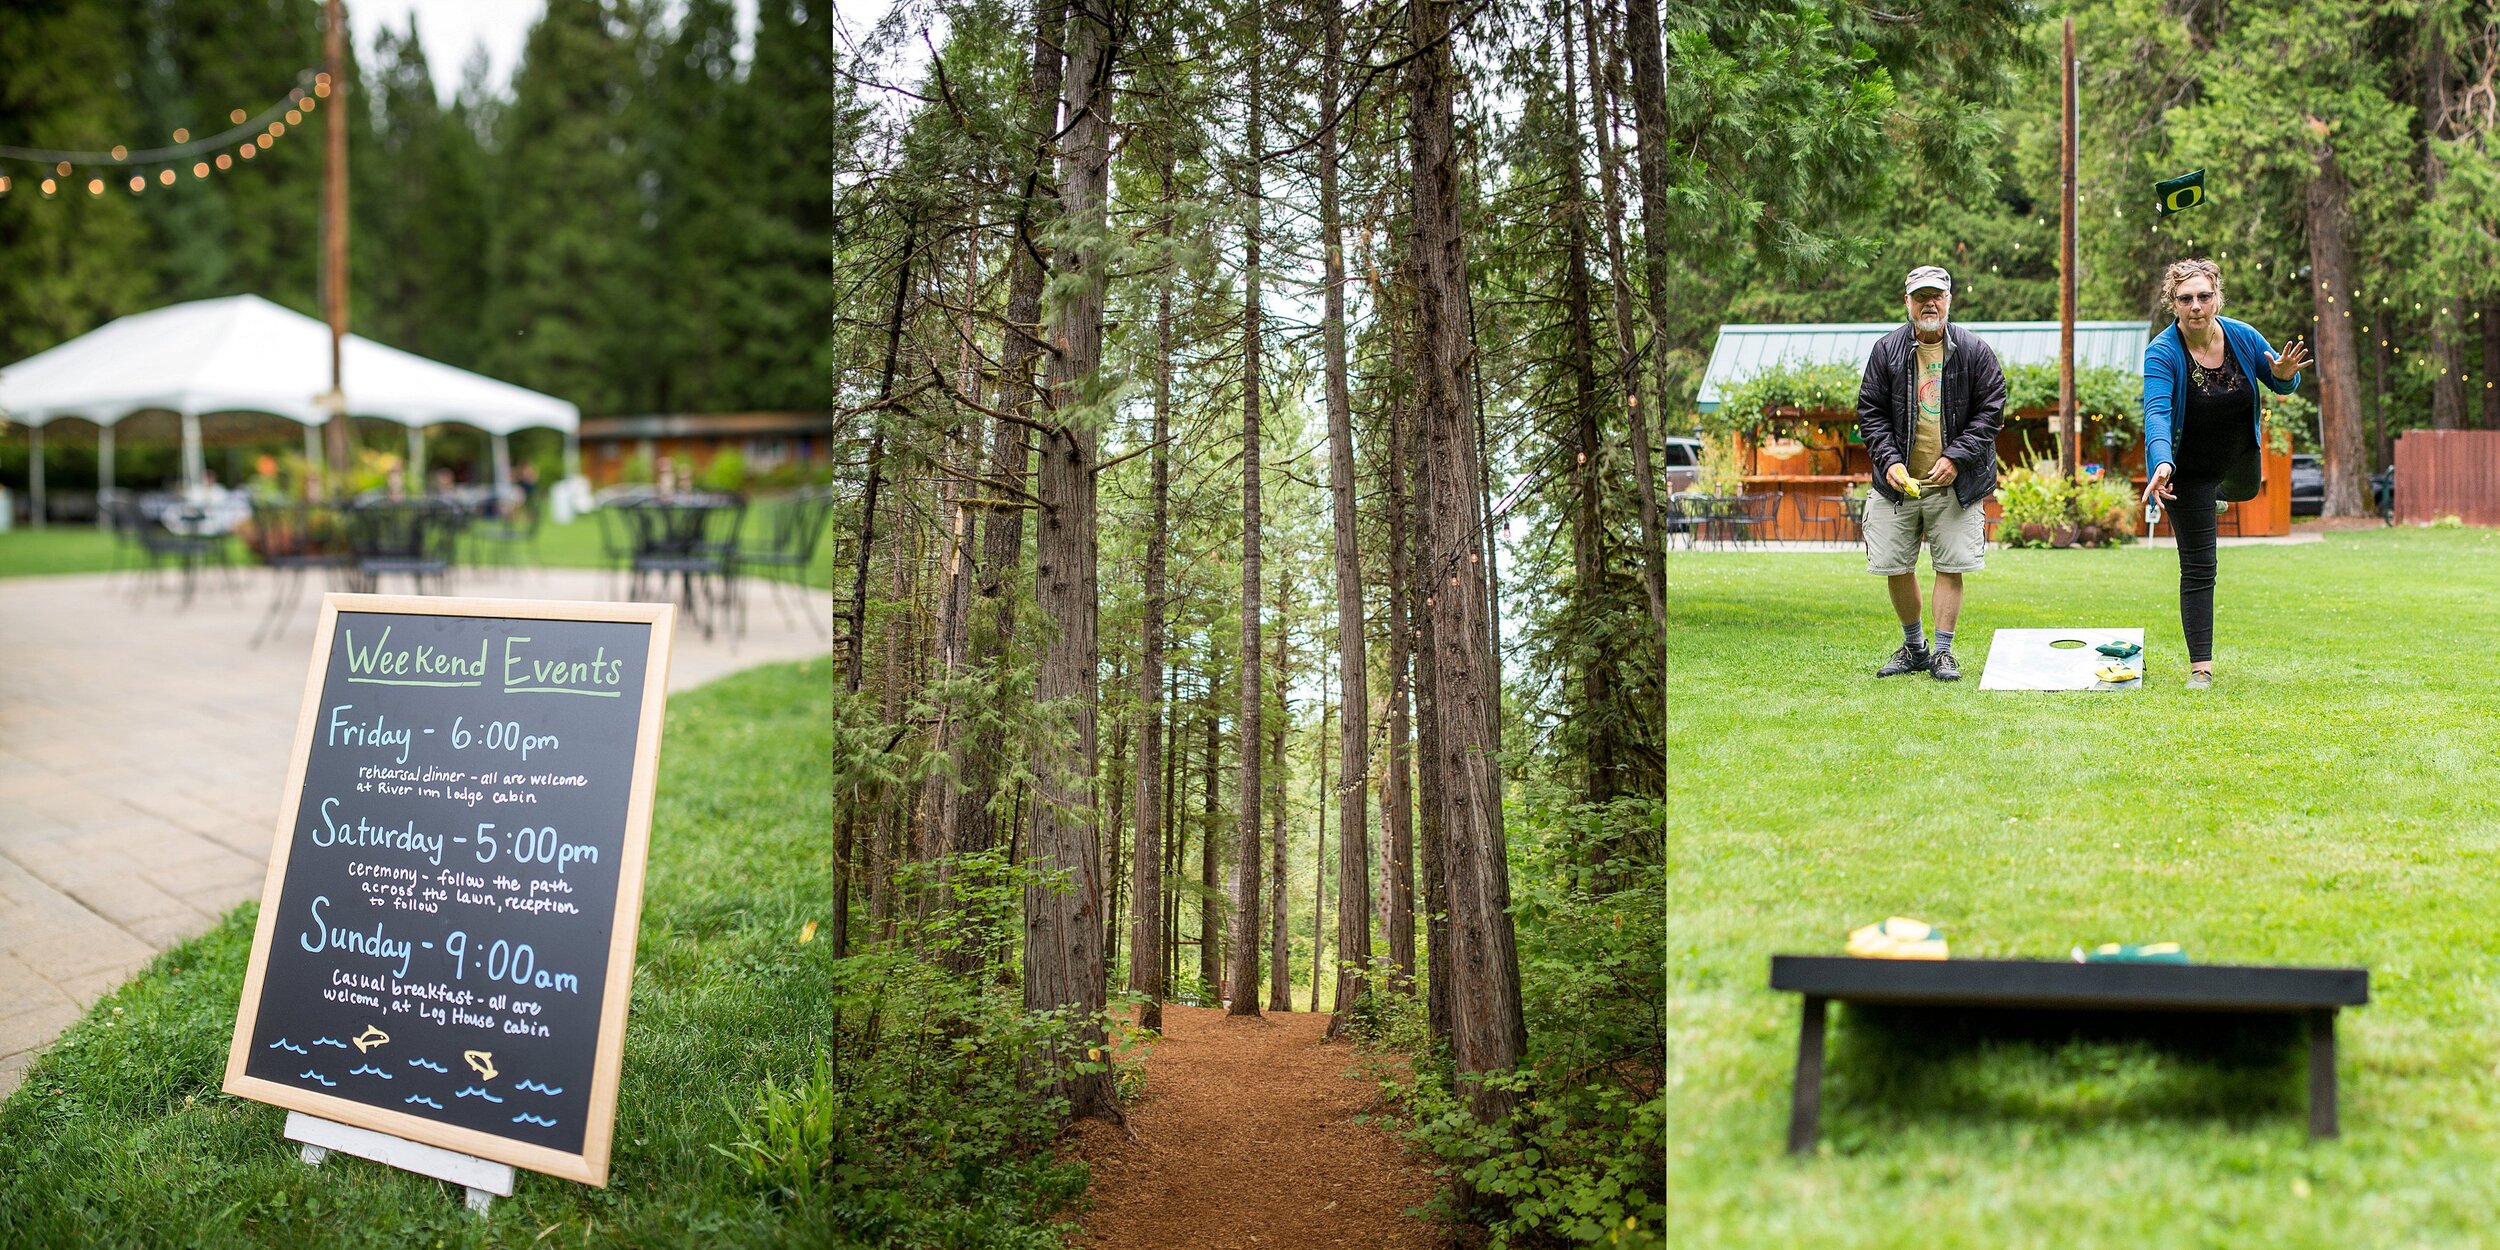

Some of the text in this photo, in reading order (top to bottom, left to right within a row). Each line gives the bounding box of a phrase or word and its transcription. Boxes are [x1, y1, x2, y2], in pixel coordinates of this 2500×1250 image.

[345, 625, 623, 686] Weekend Events
[328, 704, 411, 764] Friday
[451, 716, 559, 761] 6:00pm
[356, 781, 372, 793] at
[378, 781, 413, 796] River
[492, 790, 537, 804] cabin
[359, 765, 421, 783] rehearsal
[422, 766, 466, 783] dinner
[480, 771, 499, 786] all
[503, 773, 526, 786] are
[530, 772, 588, 787] welcome
[313, 797, 444, 866] Saturday
[475, 823, 598, 873] 5:00pm
[361, 881, 414, 897] across
[422, 887, 448, 902] the
[505, 896, 580, 915] reception
[369, 896, 438, 914] to follow
[437, 869, 485, 888] follow
[493, 875, 521, 892] the
[530, 878, 573, 898] path
[301, 896, 411, 979] Sunday
[446, 930, 578, 995] 9:00am
[323, 988, 550, 1037] welcome, at Log House cabin
[332, 968, 386, 993] Casual
[391, 979, 474, 1006] breakfast
[488, 994, 507, 1011] all
[512, 1000, 542, 1016] are
